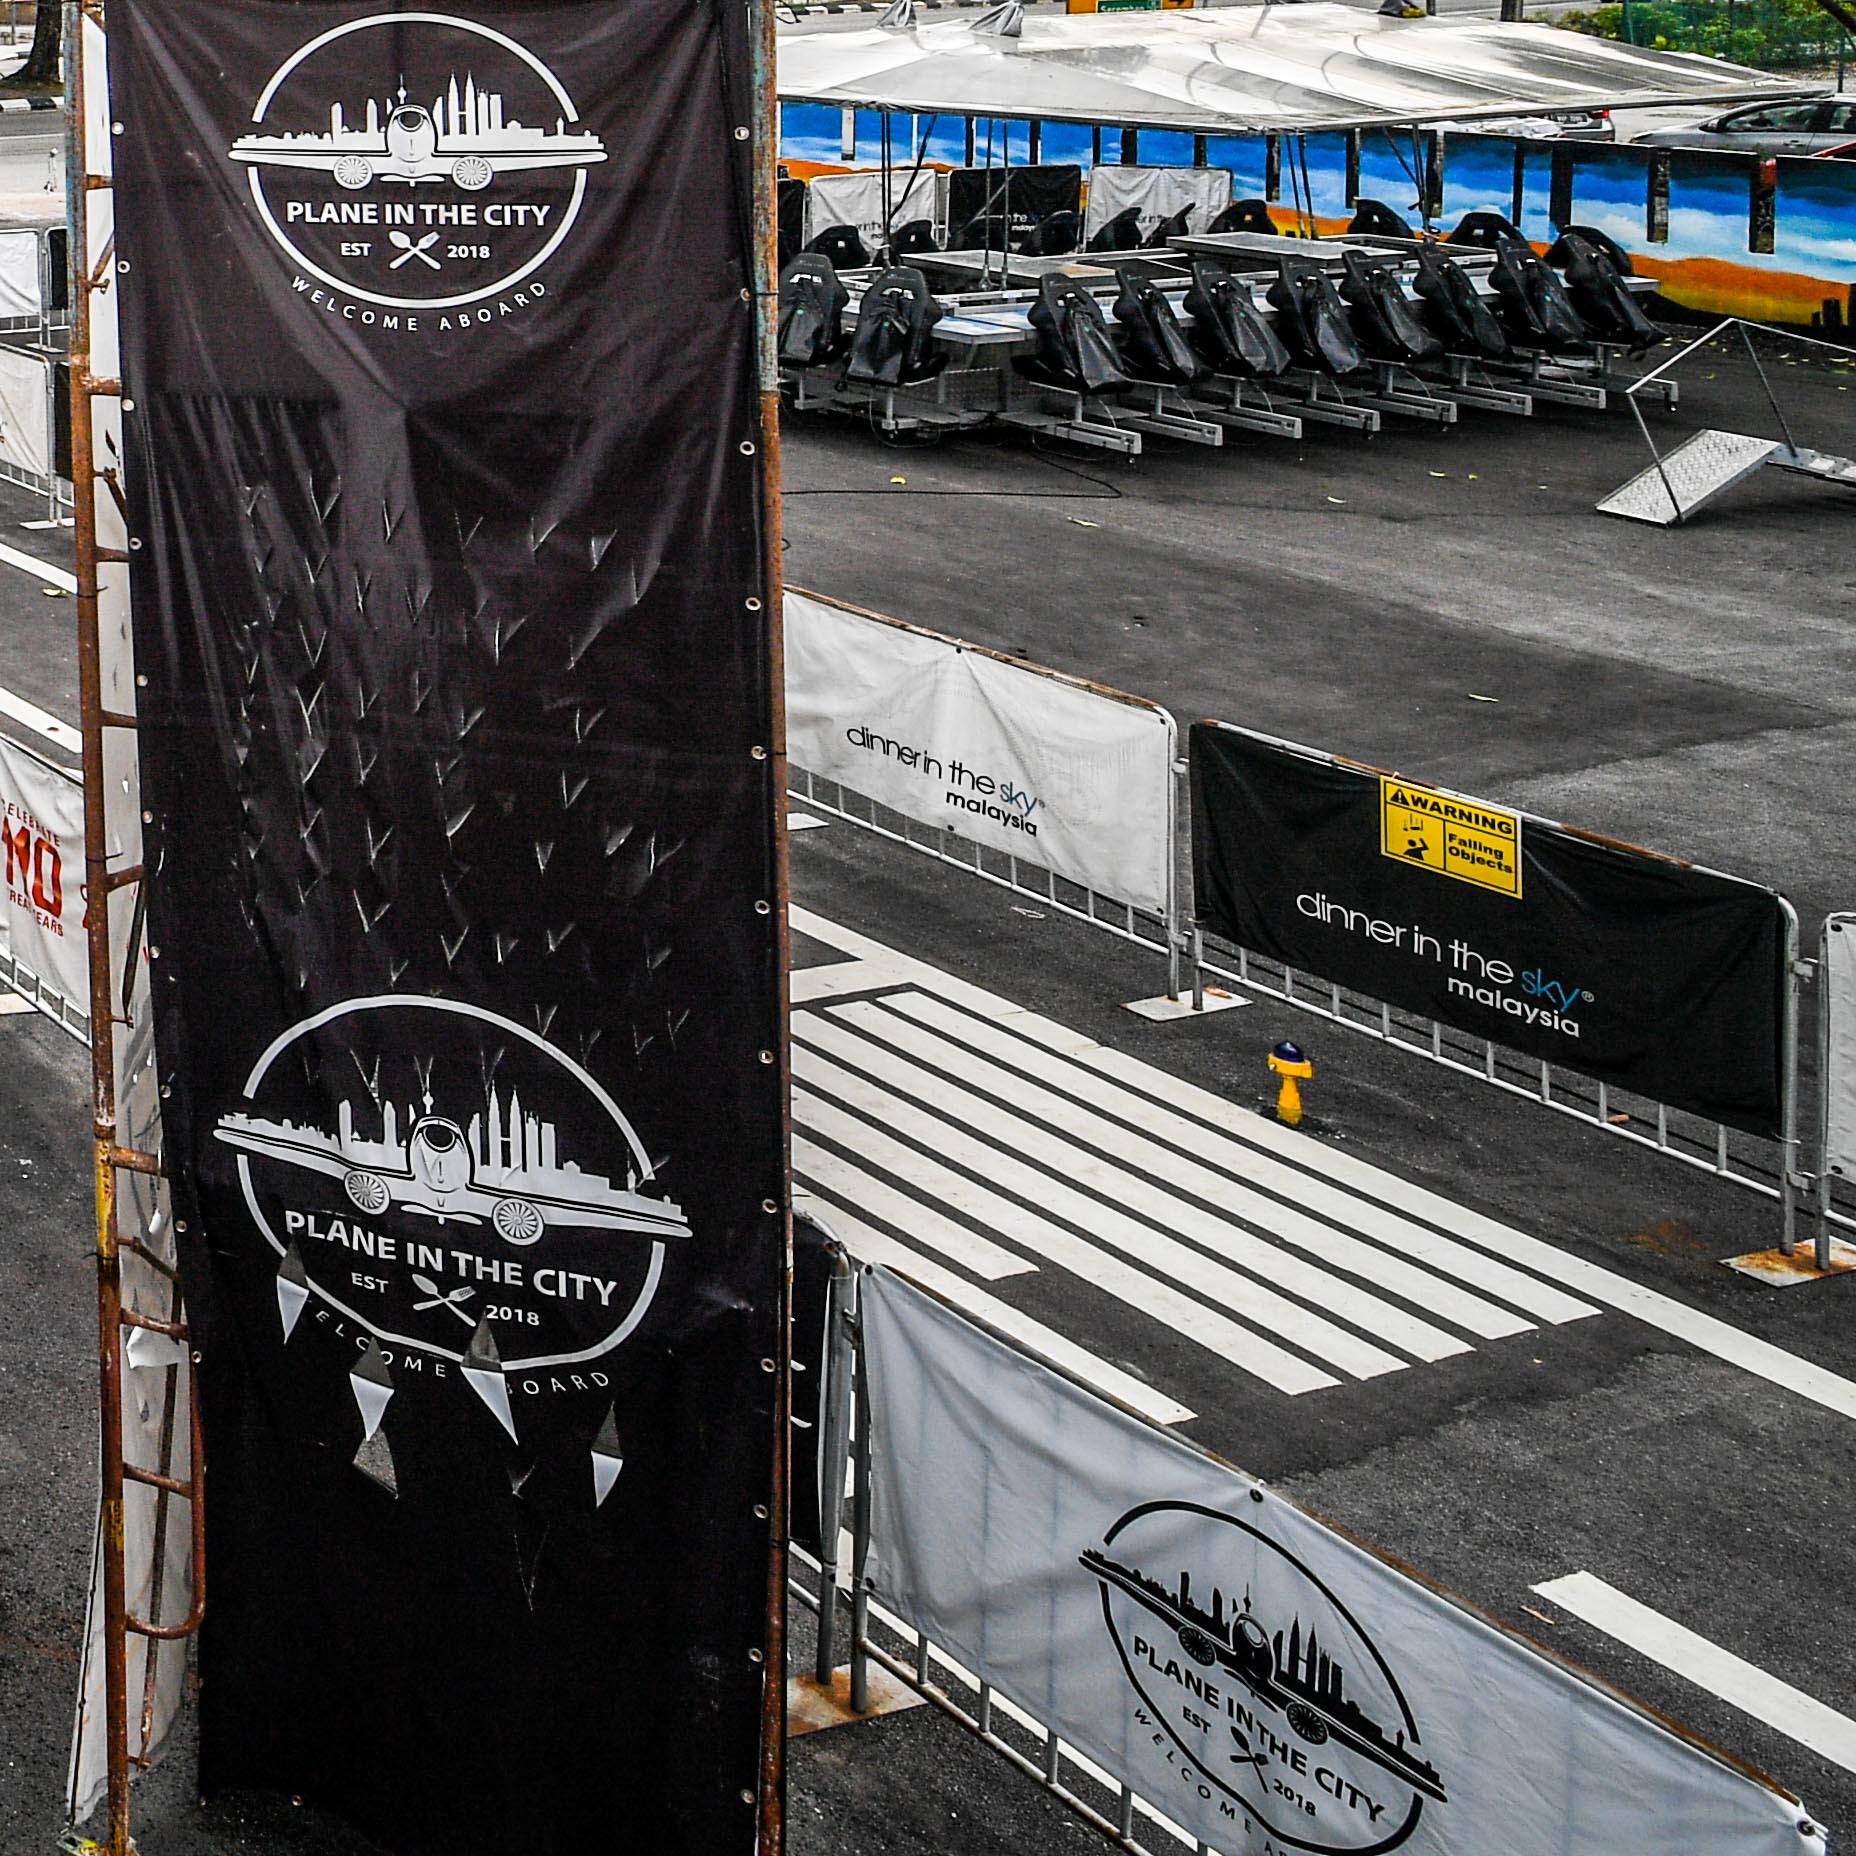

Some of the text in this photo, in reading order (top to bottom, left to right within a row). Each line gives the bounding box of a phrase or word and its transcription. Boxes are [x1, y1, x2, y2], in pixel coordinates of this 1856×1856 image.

[287, 201, 551, 227] PLANE IN THE CITY
[341, 242, 491, 260] EST 2018
[291, 276, 548, 332] WELCOME ABOARD
[847, 726, 921, 768] dinner
[923, 750, 942, 779] in
[948, 760, 995, 794] the
[946, 792, 1038, 837] malaysia
[1411, 794, 1513, 834] WARNING
[1448, 833, 1504, 860] Falling
[1448, 846, 1513, 873] Objects
[1296, 892, 1407, 947] dinner
[1413, 925, 1441, 962] in
[1448, 939, 1514, 984] the
[1448, 977, 1580, 1038] malaysia
[285, 1211, 617, 1307] PLANE IN THE CITY
[351, 1271, 540, 1326] EST 2018
[314, 1308, 446, 1378] ELCOME
[1133, 1635, 1384, 1824] PLANE IN THE CITY
[1134, 1708, 1253, 1834] WELCOME
[1182, 1706, 1317, 1818] EST 2018
